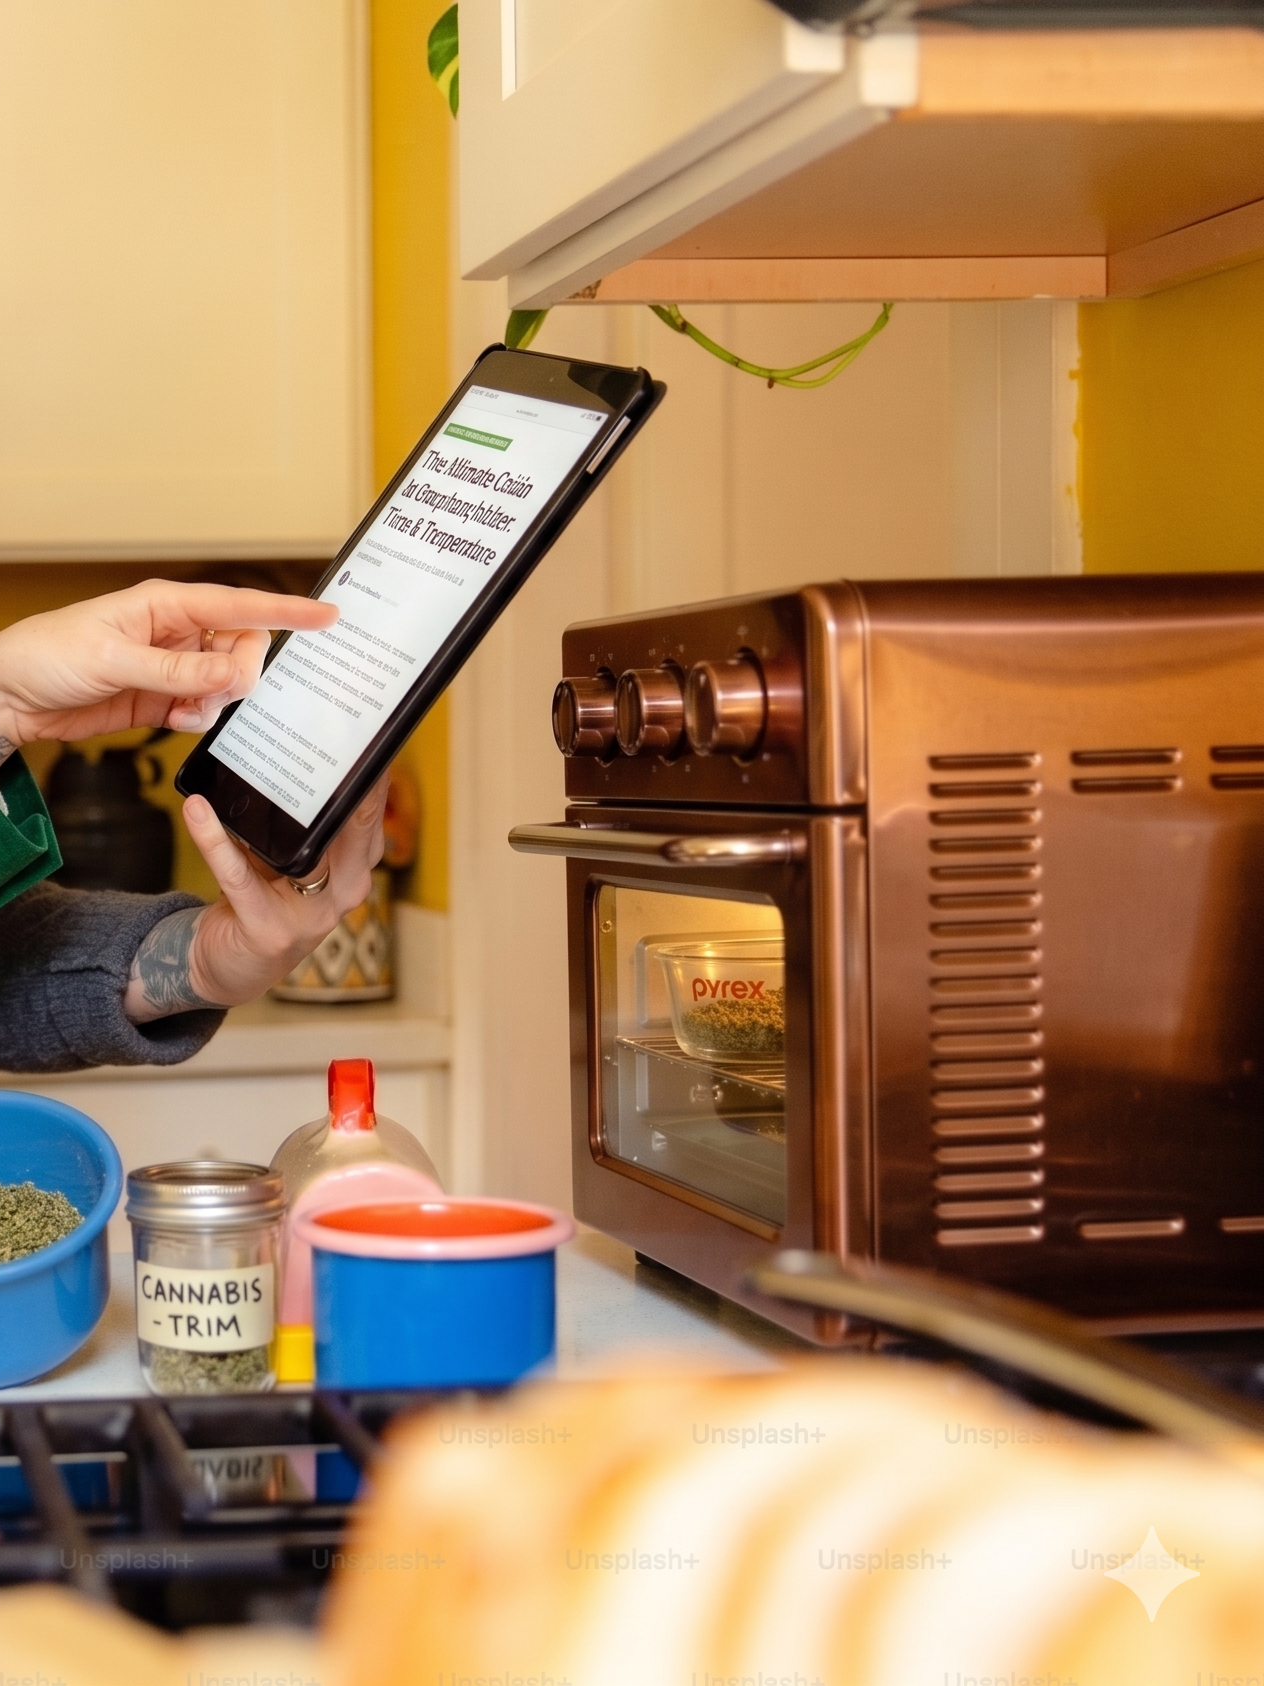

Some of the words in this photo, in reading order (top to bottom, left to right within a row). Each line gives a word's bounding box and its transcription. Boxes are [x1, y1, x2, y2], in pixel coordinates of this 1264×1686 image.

[422, 449, 449, 474] The
[692, 977, 766, 1002] pyrex
[142, 1274, 262, 1305] CANNABIS
